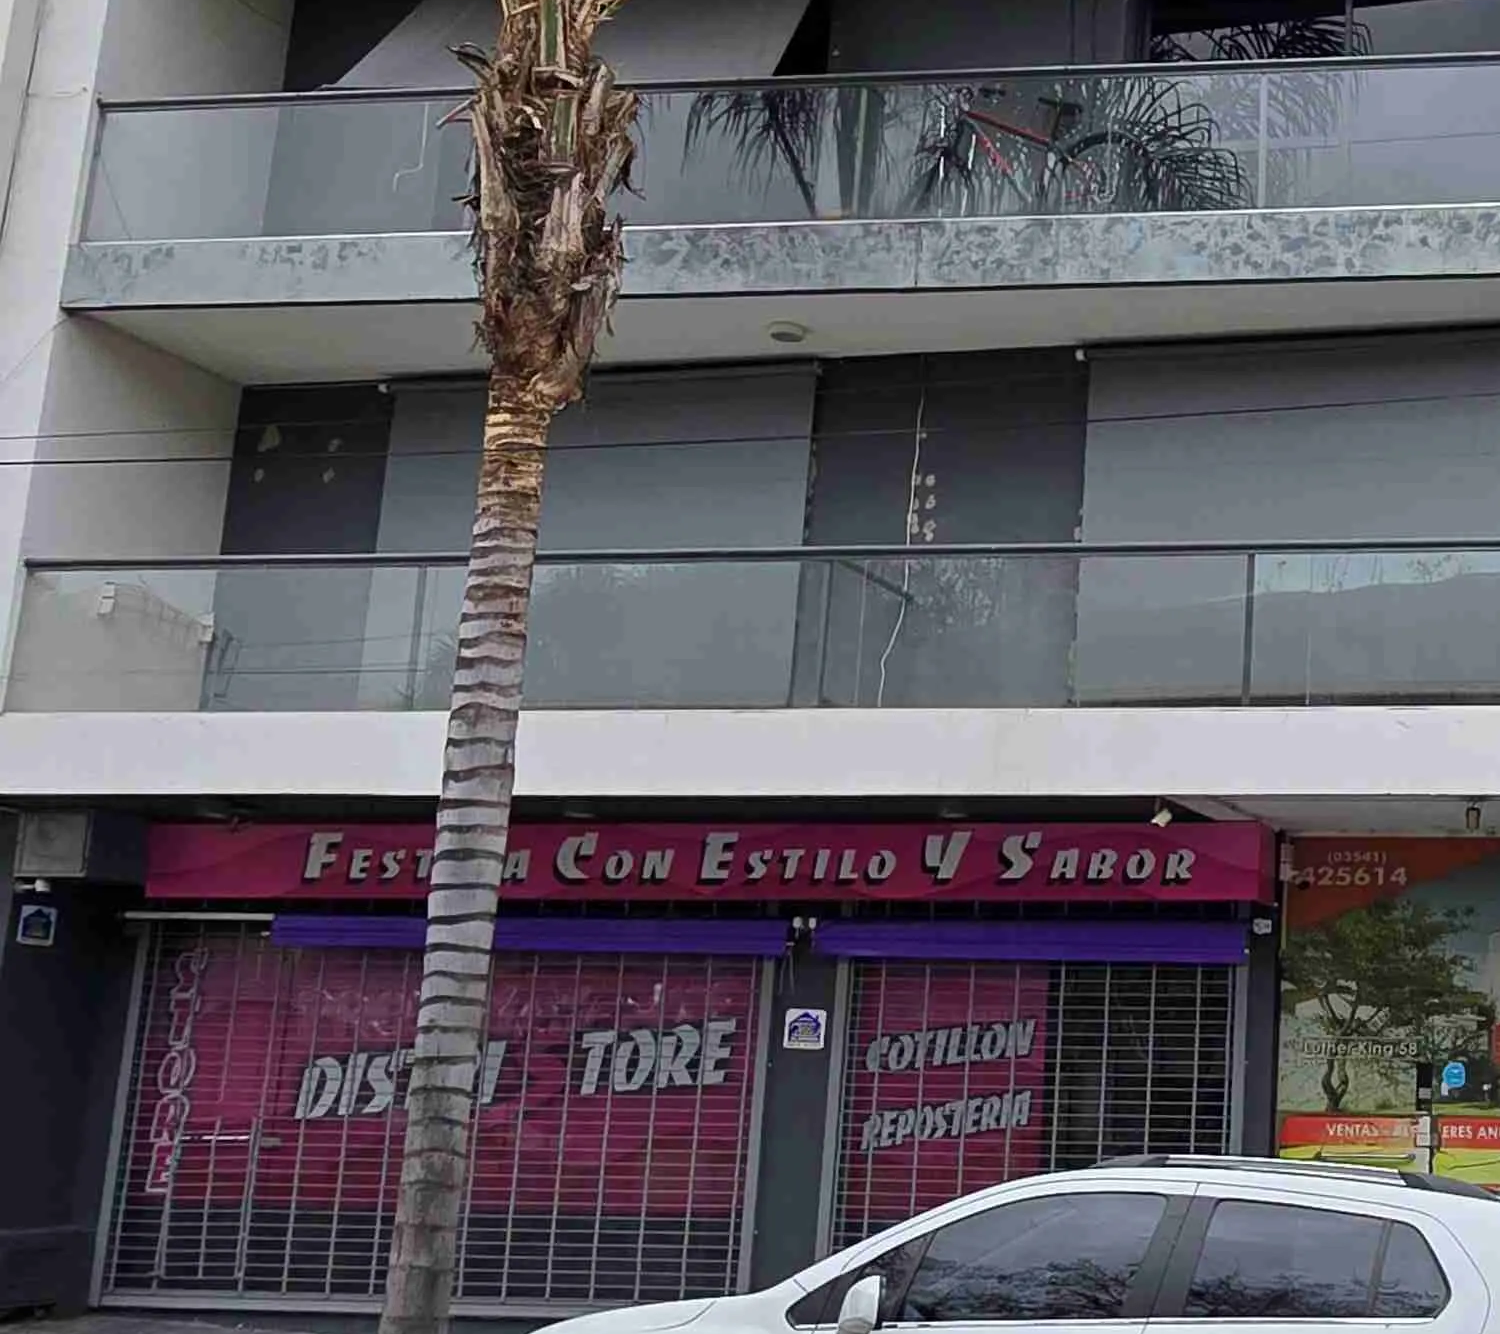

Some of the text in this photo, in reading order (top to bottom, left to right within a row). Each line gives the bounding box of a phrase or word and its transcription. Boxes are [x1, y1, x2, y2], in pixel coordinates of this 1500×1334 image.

[923, 831, 972, 879] Y
[865, 1018, 1037, 1072] COTILLON
[1398, 1042, 1418, 1056] 58
[1326, 1122, 1379, 1138] VENTAS
